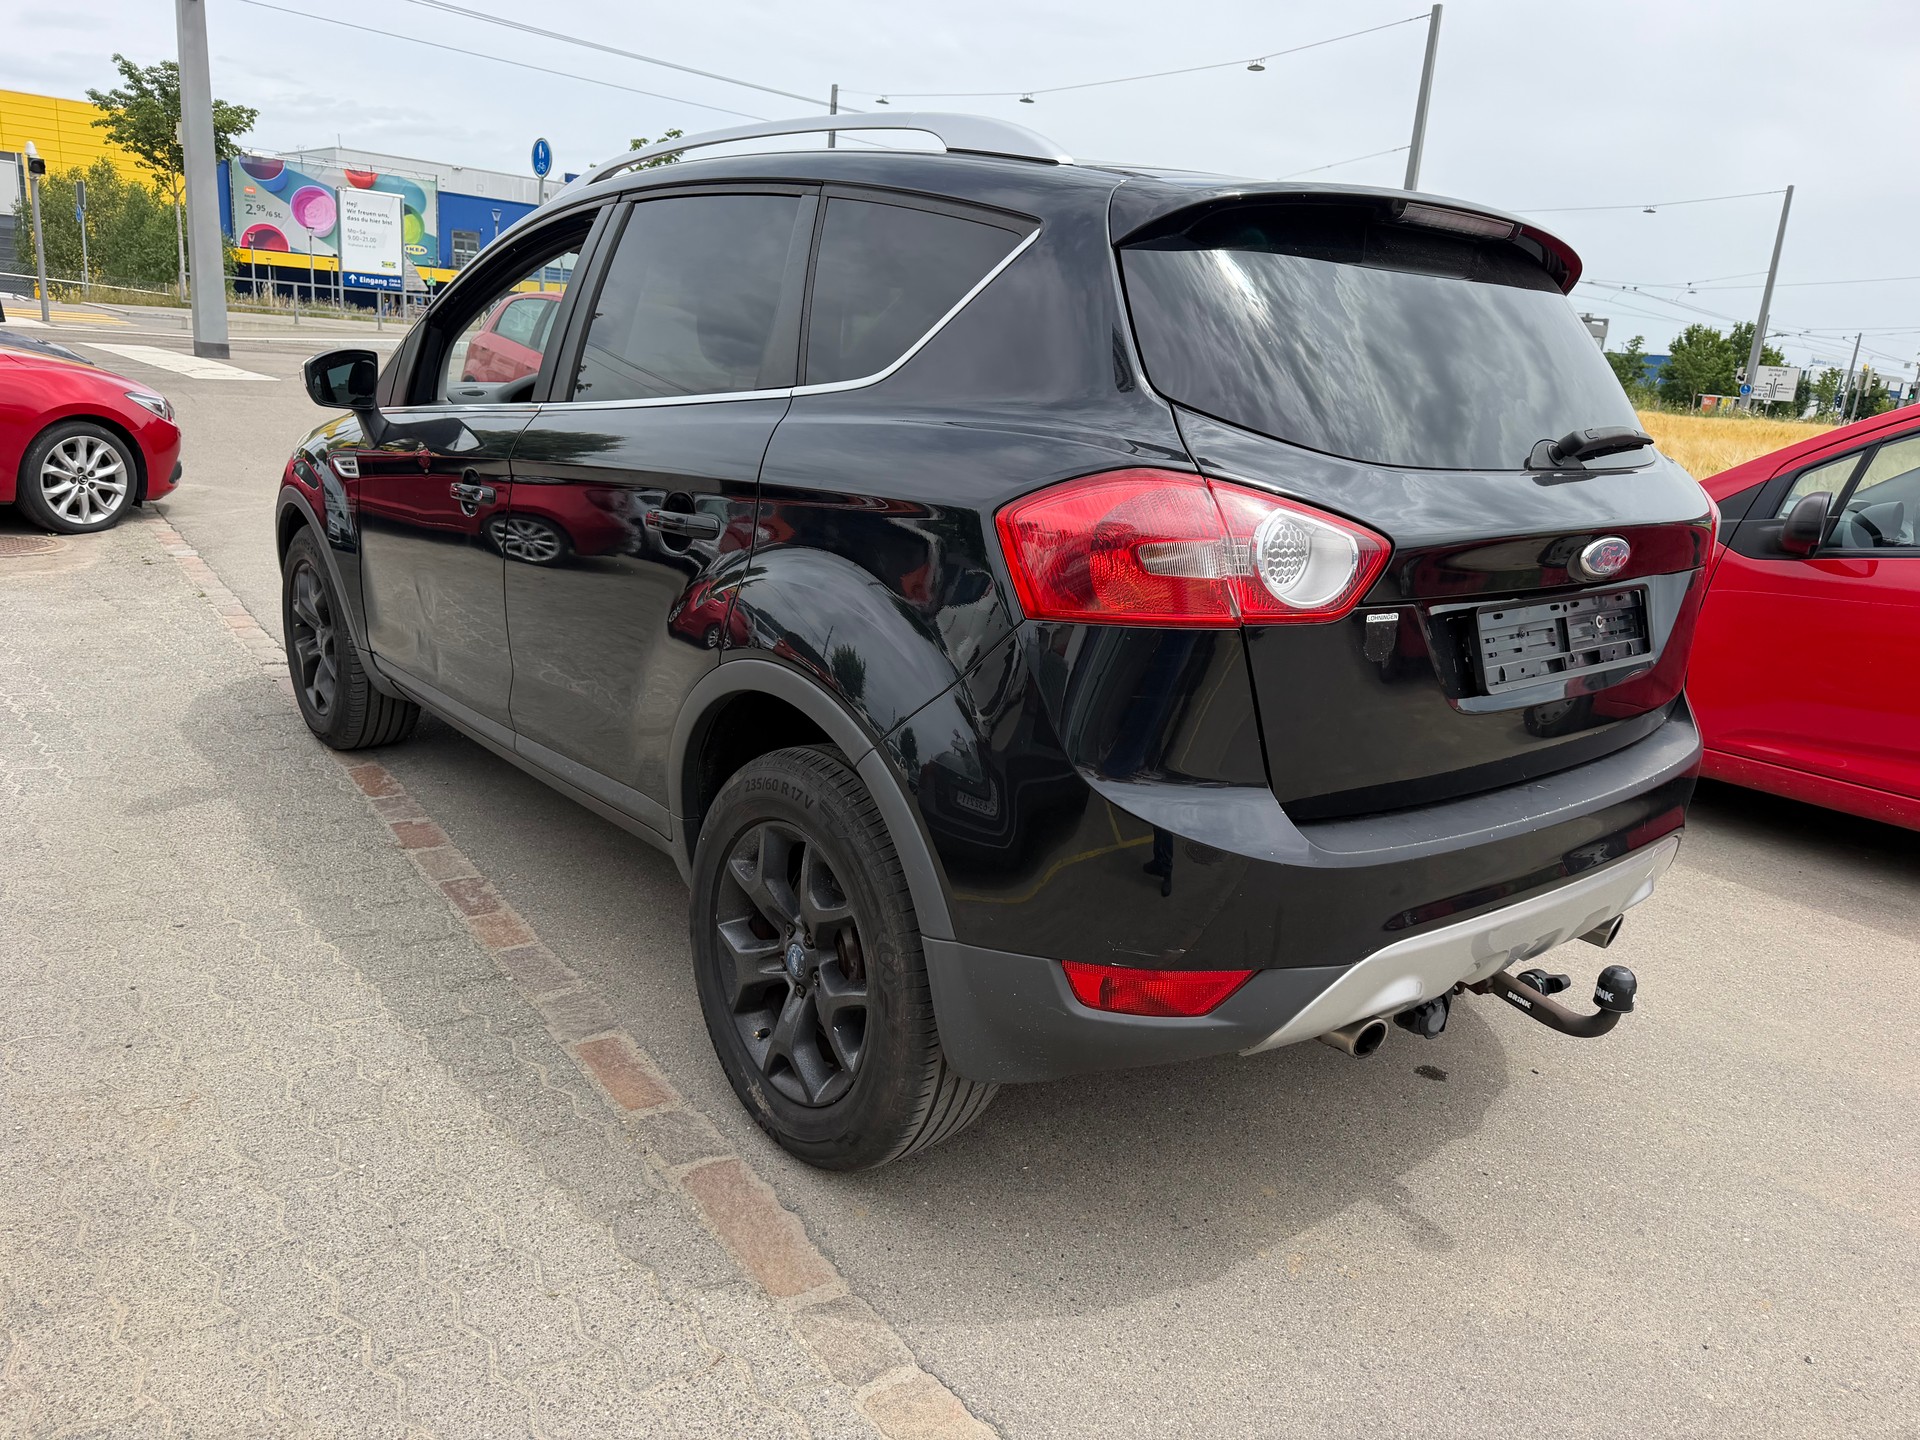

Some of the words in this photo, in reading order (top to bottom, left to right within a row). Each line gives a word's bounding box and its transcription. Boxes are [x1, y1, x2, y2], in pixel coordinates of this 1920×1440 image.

[359, 276, 388, 287] Eingang
[745, 777, 779, 792] 235/60
[780, 782, 789, 796] R
[791, 786, 804, 801] 17
[804, 795, 814, 809] V
